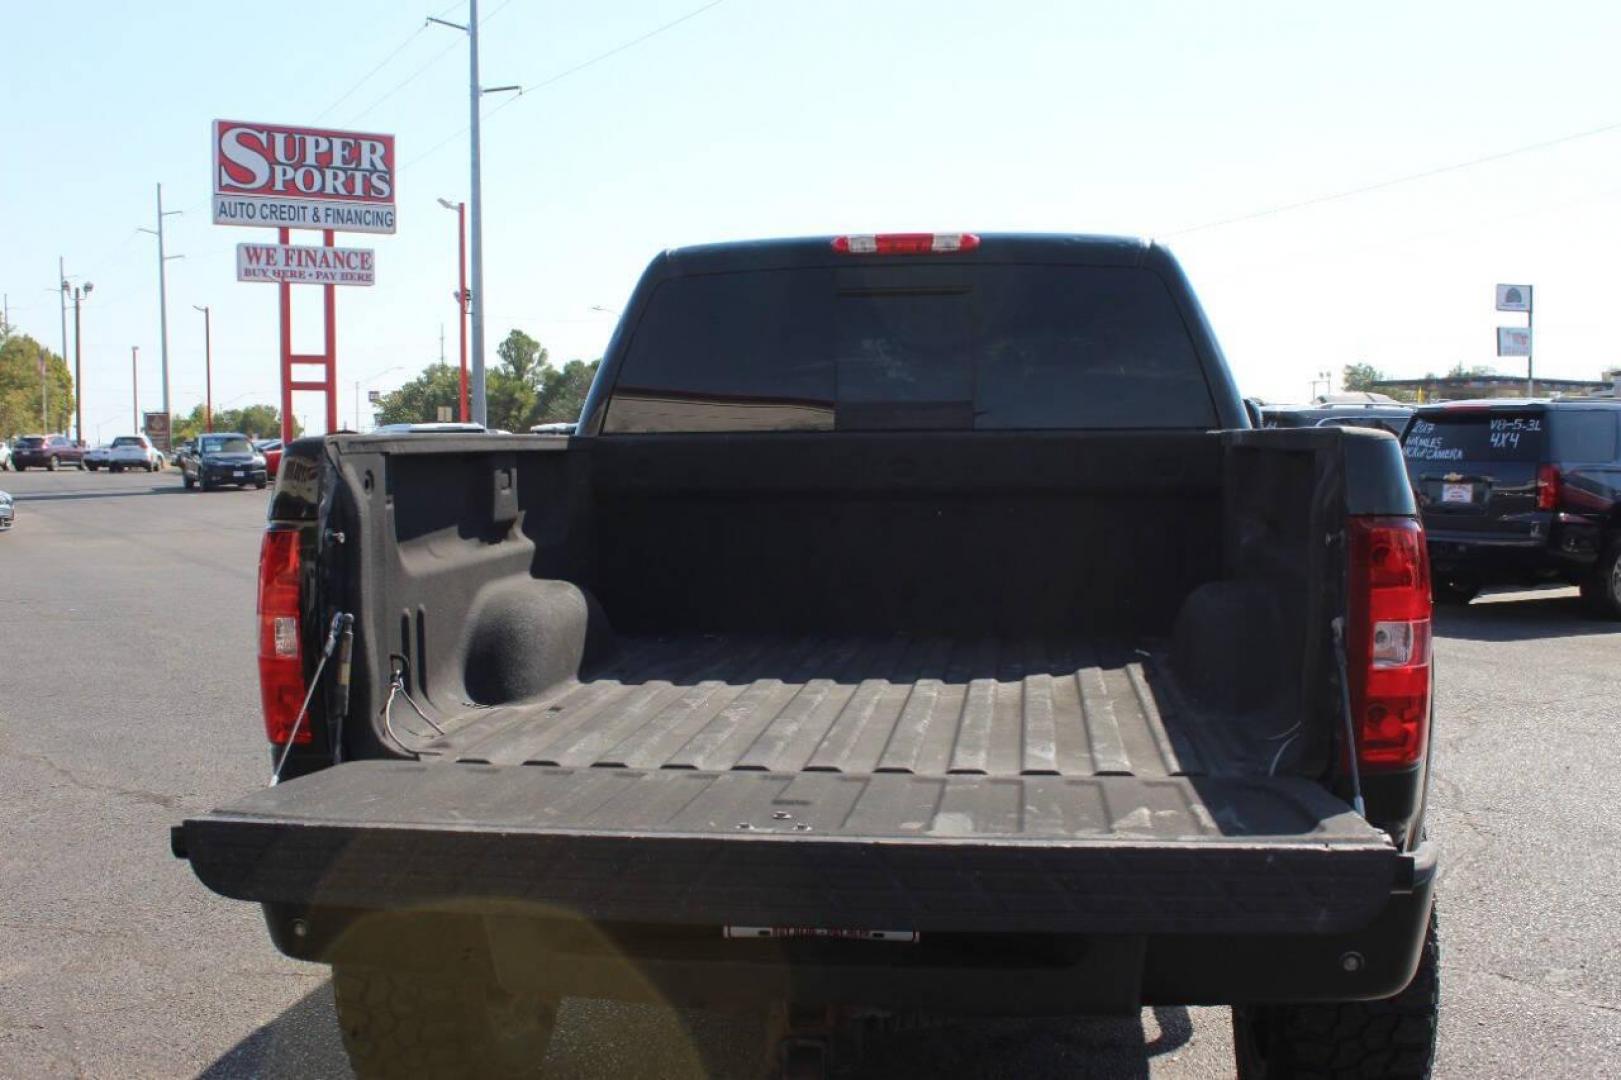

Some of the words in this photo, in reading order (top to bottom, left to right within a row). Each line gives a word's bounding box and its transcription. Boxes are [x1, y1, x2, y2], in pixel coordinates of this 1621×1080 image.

[221, 127, 388, 189] SUPER
[218, 201, 256, 219] AUTO
[260, 203, 308, 222] CREDIT
[312, 207, 322, 224] &
[325, 208, 394, 228] FINANCING
[245, 247, 277, 266] WE
[284, 248, 373, 271] FINANCE
[244, 267, 269, 277] BUY
[272, 269, 306, 280] HERE
[315, 271, 337, 281] PAY
[340, 271, 373, 282] HERE
